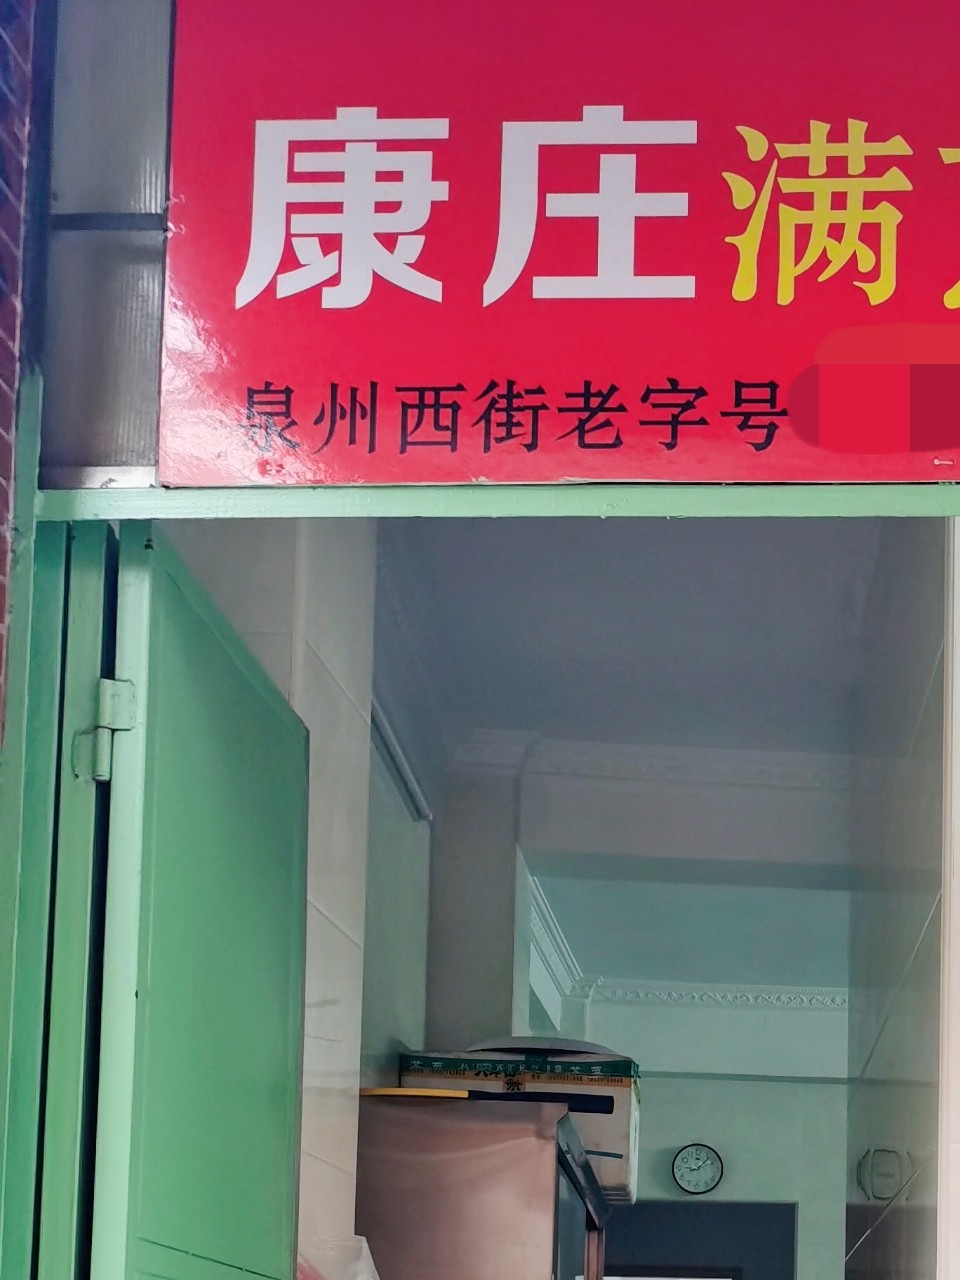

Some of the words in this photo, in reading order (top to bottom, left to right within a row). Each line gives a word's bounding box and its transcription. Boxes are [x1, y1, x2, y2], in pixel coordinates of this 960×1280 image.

[238, 378, 789, 455] 泉州西街老字号
